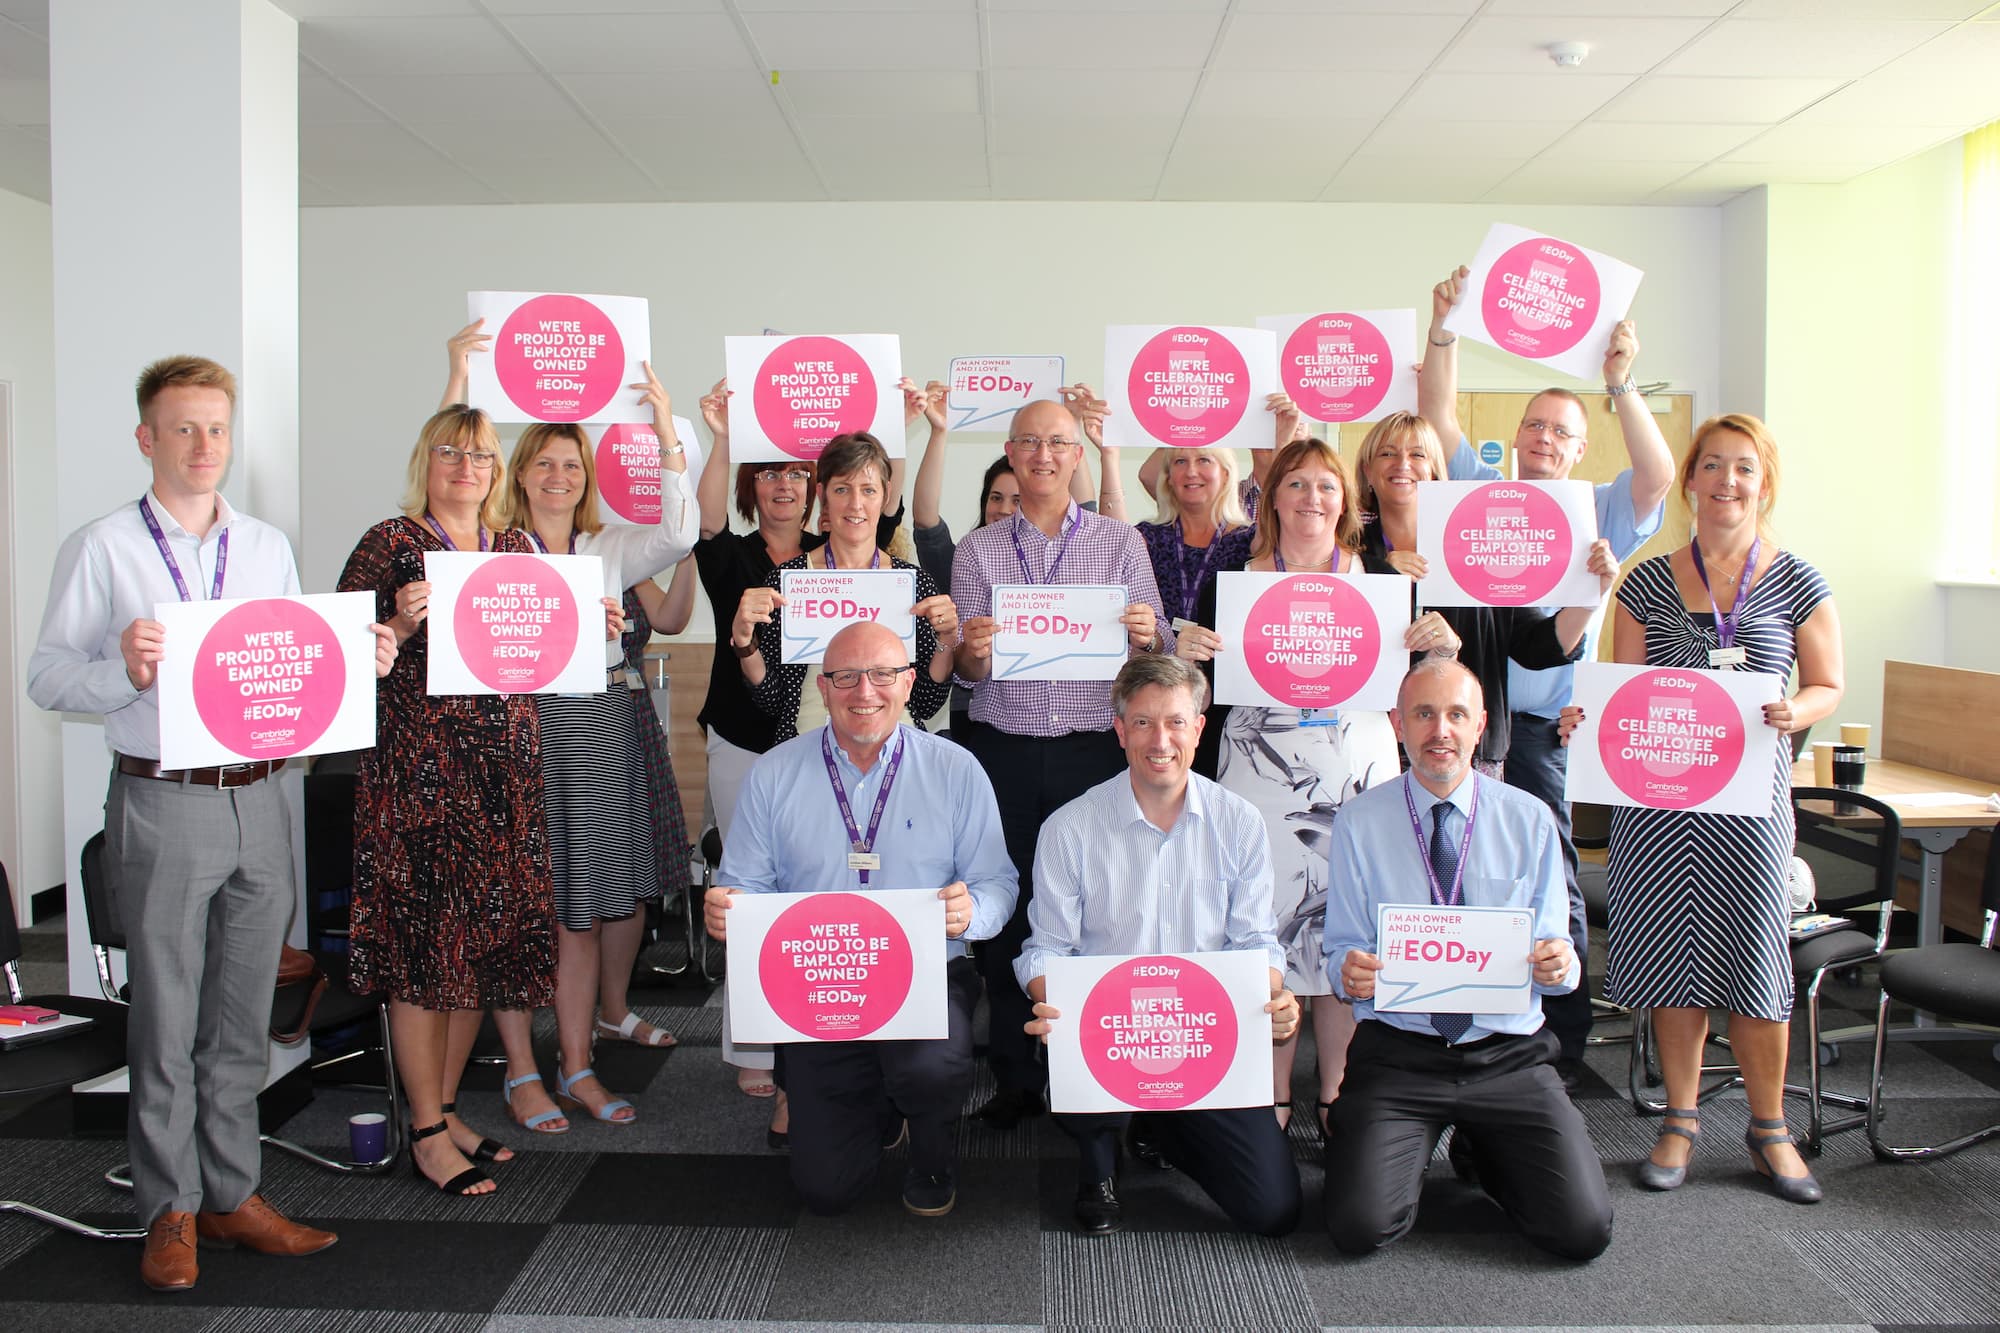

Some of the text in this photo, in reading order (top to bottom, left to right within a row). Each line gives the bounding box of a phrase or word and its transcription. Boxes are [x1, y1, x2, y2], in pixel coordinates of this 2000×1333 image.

[1540, 245, 1575, 264] #EODay
[1530, 268, 1568, 289] WE'RE
[1503, 273, 1586, 309] CELEBRATING
[1508, 287, 1572, 317] EMPLOYEE
[1498, 298, 1573, 330] OWNERSHIP
[539, 321, 581, 332] WE'RE
[1318, 320, 1352, 330] #EODay
[514, 334, 605, 345] PROUD TO BE
[1172, 334, 1209, 346] #EODay
[524, 347, 596, 358] EMPLOYEE
[1318, 343, 1355, 354] WE'RE
[533, 360, 587, 371] OWNED
[1169, 360, 1210, 371] WE'RE
[1295, 354, 1378, 366] CELEBRATING
[794, 361, 834, 373] WE'RE
[1305, 365, 1369, 376] EMPLOYEE
[771, 373, 858, 385] PROUD TO BE
[1144, 372, 1235, 384] CELEBRATING
[1299, 376, 1375, 388] OWNERSHIP
[536, 379, 586, 394] #EODay
[781, 386, 850, 398] EMPLOYEE
[956, 376, 1033, 398] #EODay
[1154, 384, 1224, 396] EMPLOYEE
[790, 398, 841, 409] OWNED
[1148, 397, 1229, 409] OWNERSHIP
[793, 417, 840, 432] #EODay
[612, 444, 649, 454] PROUD
[620, 455, 661, 466] EMPLOY
[628, 467, 661, 478] OWNE
[1488, 490, 1527, 502] #EODay
[1487, 516, 1529, 528] WE'RE
[1460, 529, 1555, 540] CELEBRATING
[1471, 542, 1544, 553] EMPLOYEE
[1465, 555, 1551, 566] OWNERSHIP
[497, 584, 537, 595] WE'RE
[1293, 583, 1334, 596] #EODay
[473, 597, 560, 609] PROUD TO BE
[482, 611, 551, 623] EMPLOYEE
[792, 600, 880, 622] #EODay
[1290, 612, 1335, 624] WE'RE
[490, 625, 542, 637] OWNED
[1003, 615, 1092, 642] #EODay
[1262, 624, 1363, 639] CELEBRATING
[245, 631, 294, 647] WE'RE
[1273, 639, 1351, 651] EMPLOYEE
[216, 644, 323, 666] PROUD TO BE
[493, 646, 541, 662] #EODay
[1266, 652, 1358, 666] OWNERSHIP
[228, 661, 313, 682] EMPLOYEE
[240, 677, 303, 696] OWNED
[1653, 678, 1697, 692] #EODay
[243, 703, 302, 721] #EODay
[1649, 706, 1697, 720] WE'RE
[1618, 719, 1726, 738] CELEBRATING
[1630, 734, 1713, 752] EMPLOYEE
[1621, 748, 1719, 767] OWNERSHIP
[1423, 915, 1462, 924] OWNER
[810, 923, 859, 936] WE'RE
[782, 937, 889, 953] PROUD TO BE
[793, 952, 878, 968] EMPLOYEE
[1387, 939, 1492, 972] #EODay
[805, 967, 868, 981] OWNED
[1133, 966, 1180, 979] #EODay
[808, 990, 866, 1007] #EODay
[1132, 998, 1184, 1012] WE'RE
[1100, 1012, 1216, 1029] CELEBRATING
[1114, 1029, 1204, 1044] EMPLOYEE
[1107, 1045, 1213, 1060] OWNERSHIP
